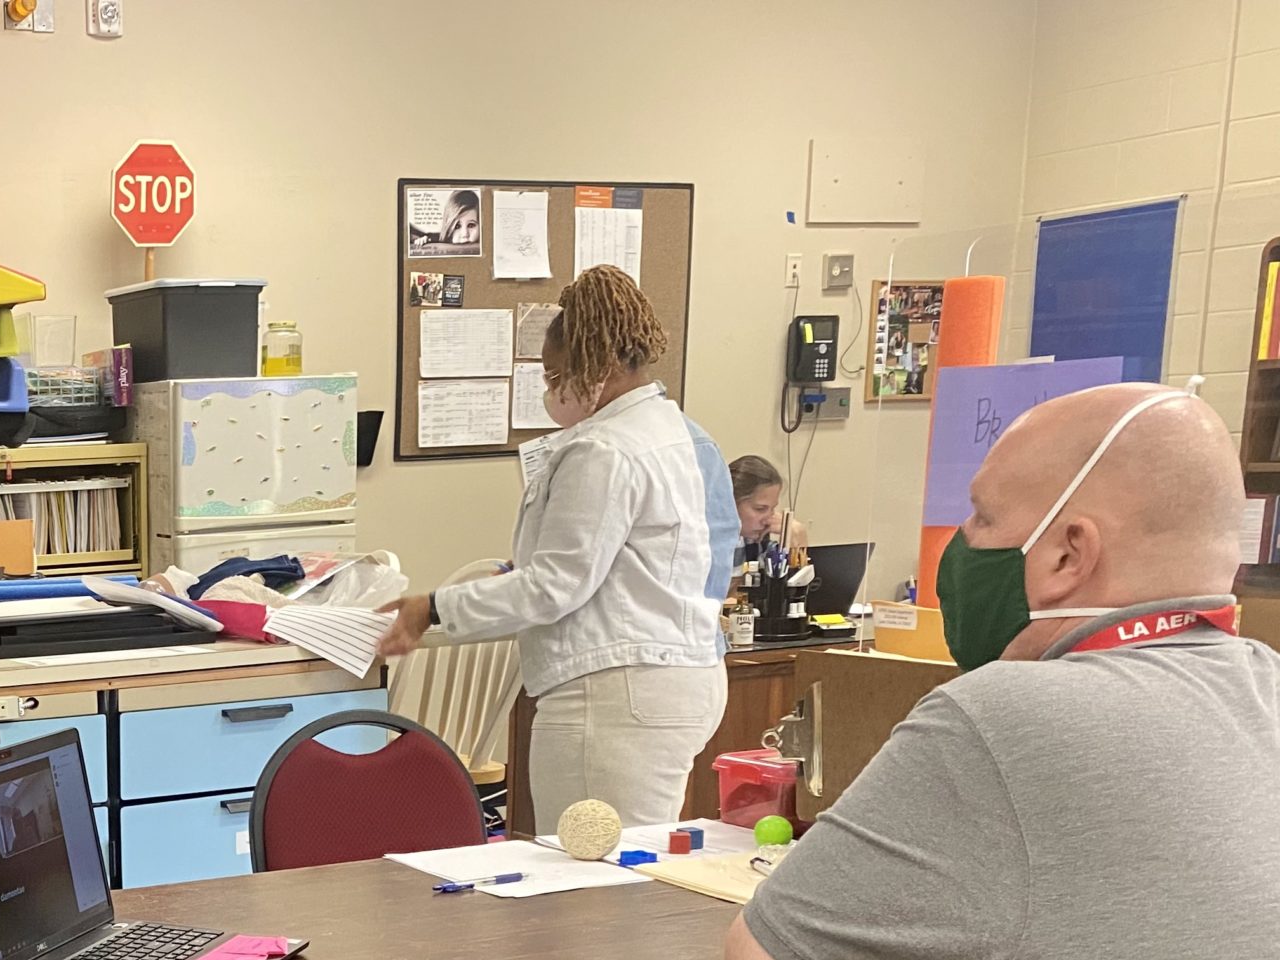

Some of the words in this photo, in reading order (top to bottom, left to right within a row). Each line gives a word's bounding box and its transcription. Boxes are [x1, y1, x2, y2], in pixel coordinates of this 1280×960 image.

[118, 174, 193, 214] STOP
[119, 366, 129, 387] play
[1117, 621, 1150, 640] LA
